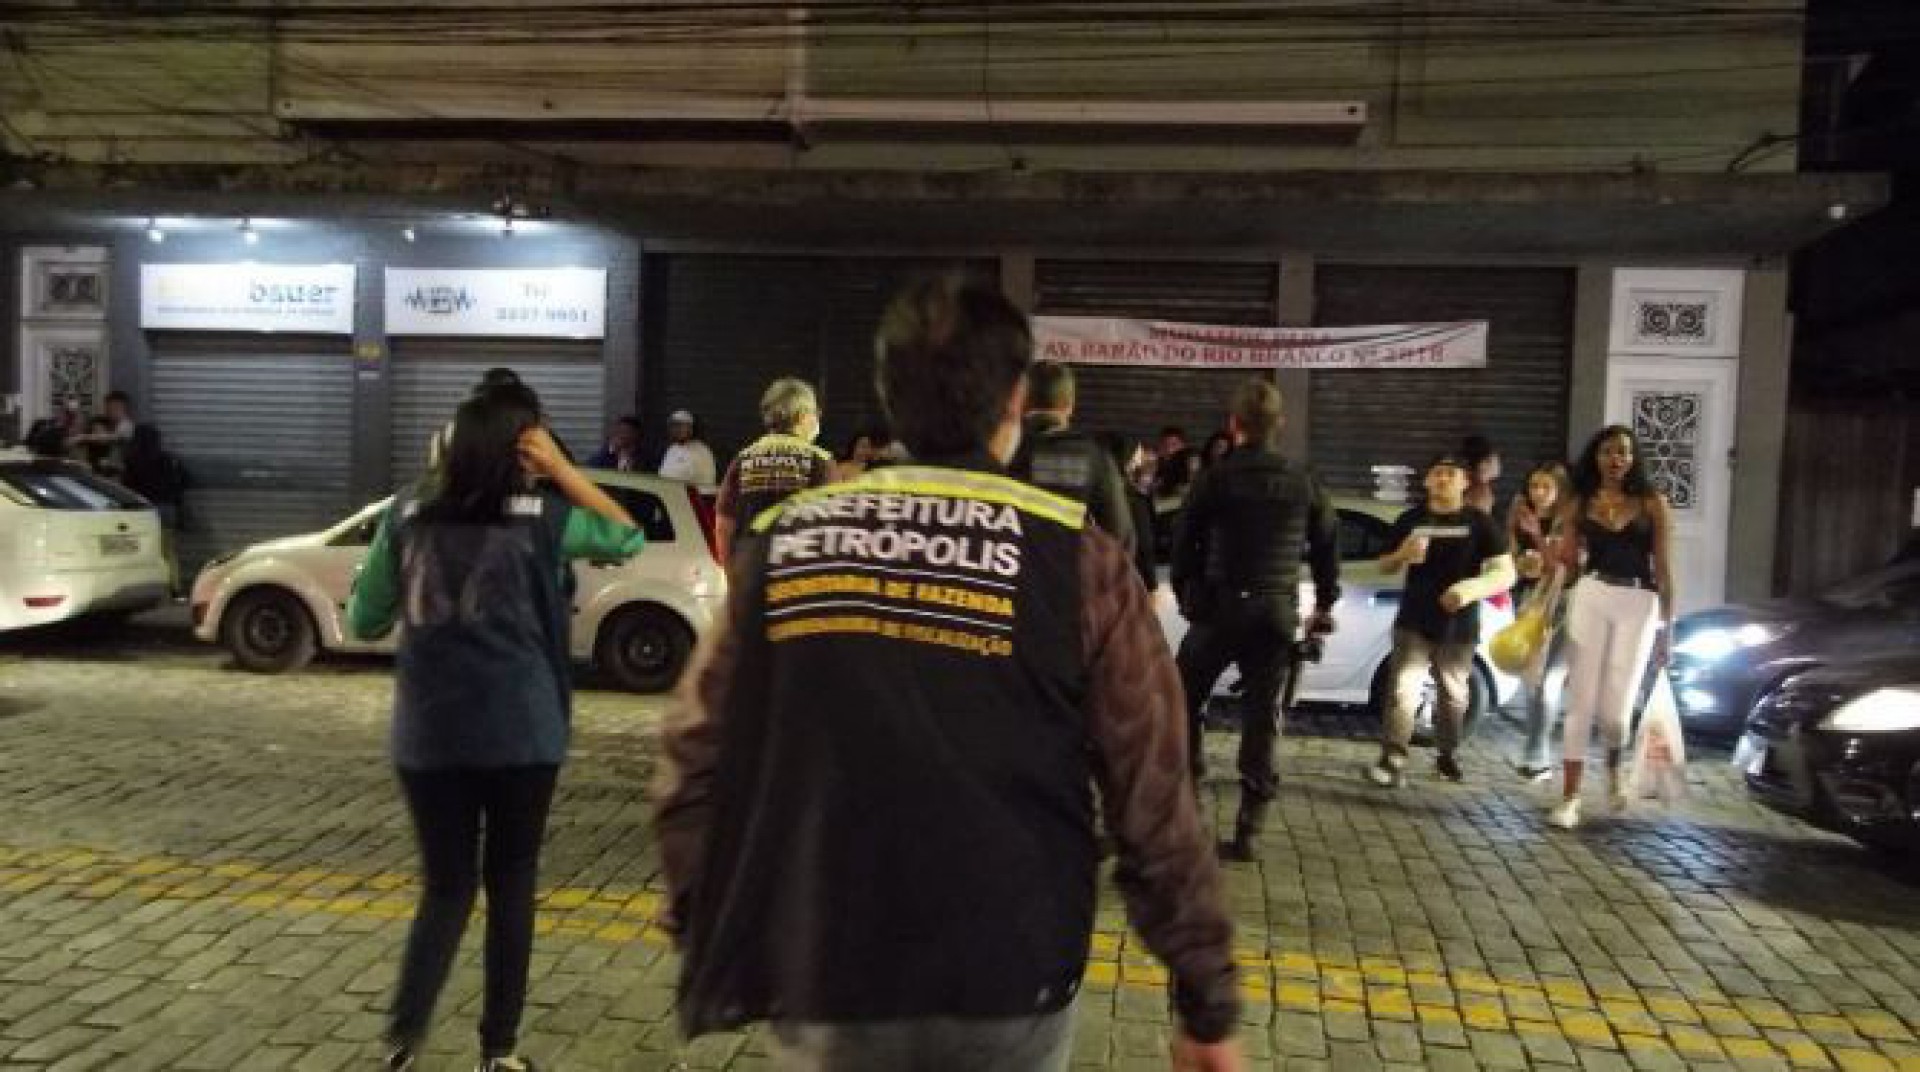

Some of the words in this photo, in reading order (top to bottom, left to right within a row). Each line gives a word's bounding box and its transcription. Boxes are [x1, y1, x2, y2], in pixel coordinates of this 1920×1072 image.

[1163, 343, 1197, 361] DO
[1203, 346, 1242, 362] RIO
[1249, 347, 1346, 364] BRANCO
[778, 493, 1024, 537] PREFEITURA
[768, 522, 1022, 576] PETRÓPOLIS
